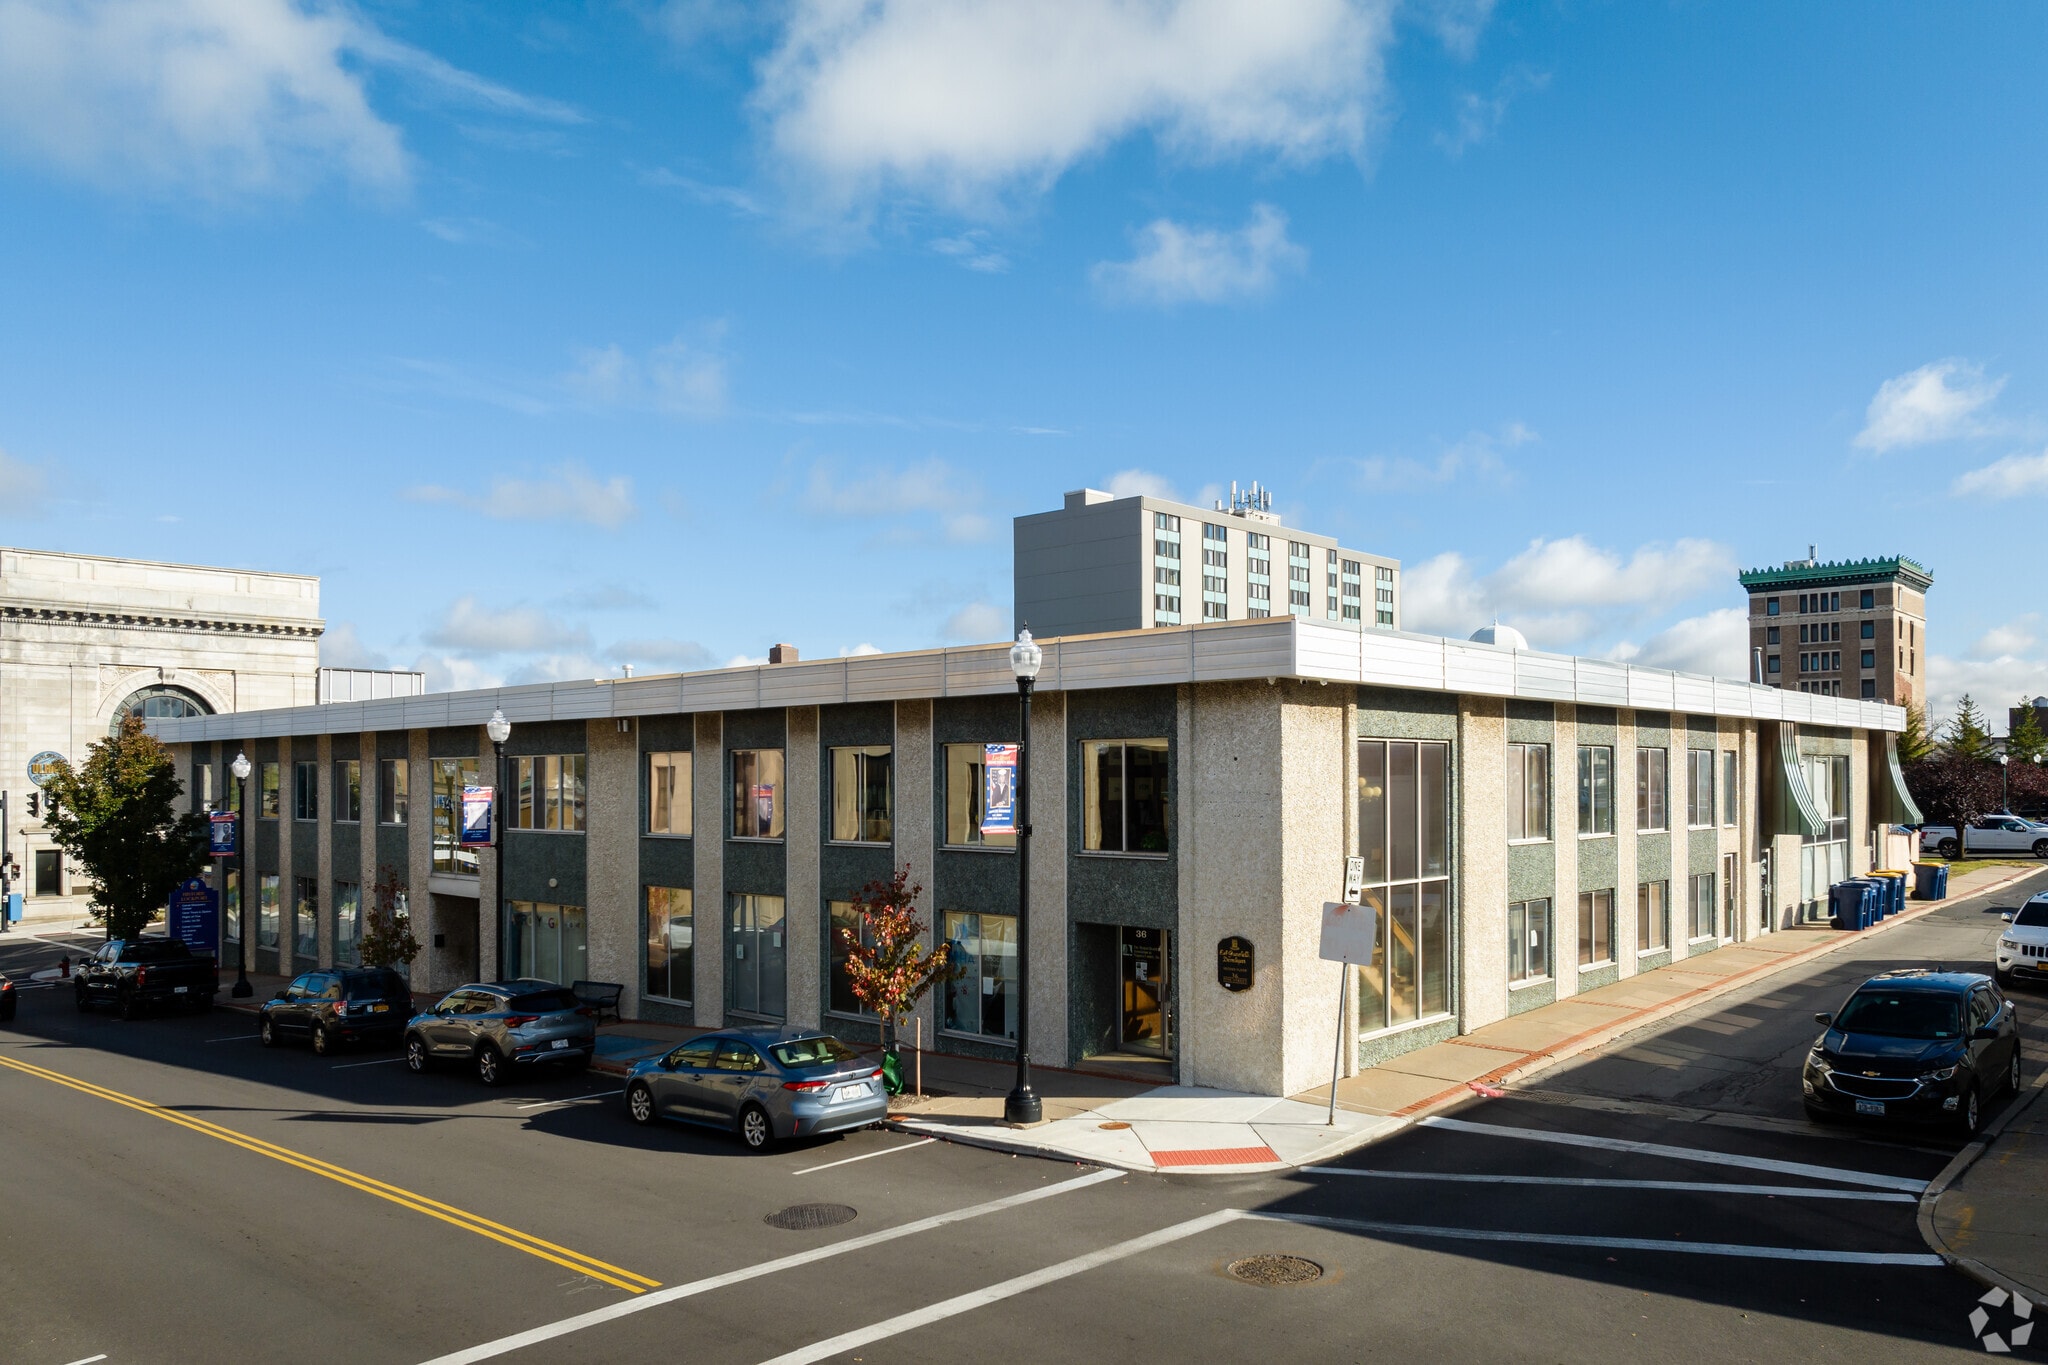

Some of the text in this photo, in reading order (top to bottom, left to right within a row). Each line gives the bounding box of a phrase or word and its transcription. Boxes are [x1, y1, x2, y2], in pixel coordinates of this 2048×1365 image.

[1350, 860, 1361, 872] ONE
[1349, 874, 1360, 884] WAY
[1135, 930, 1147, 938] 36
